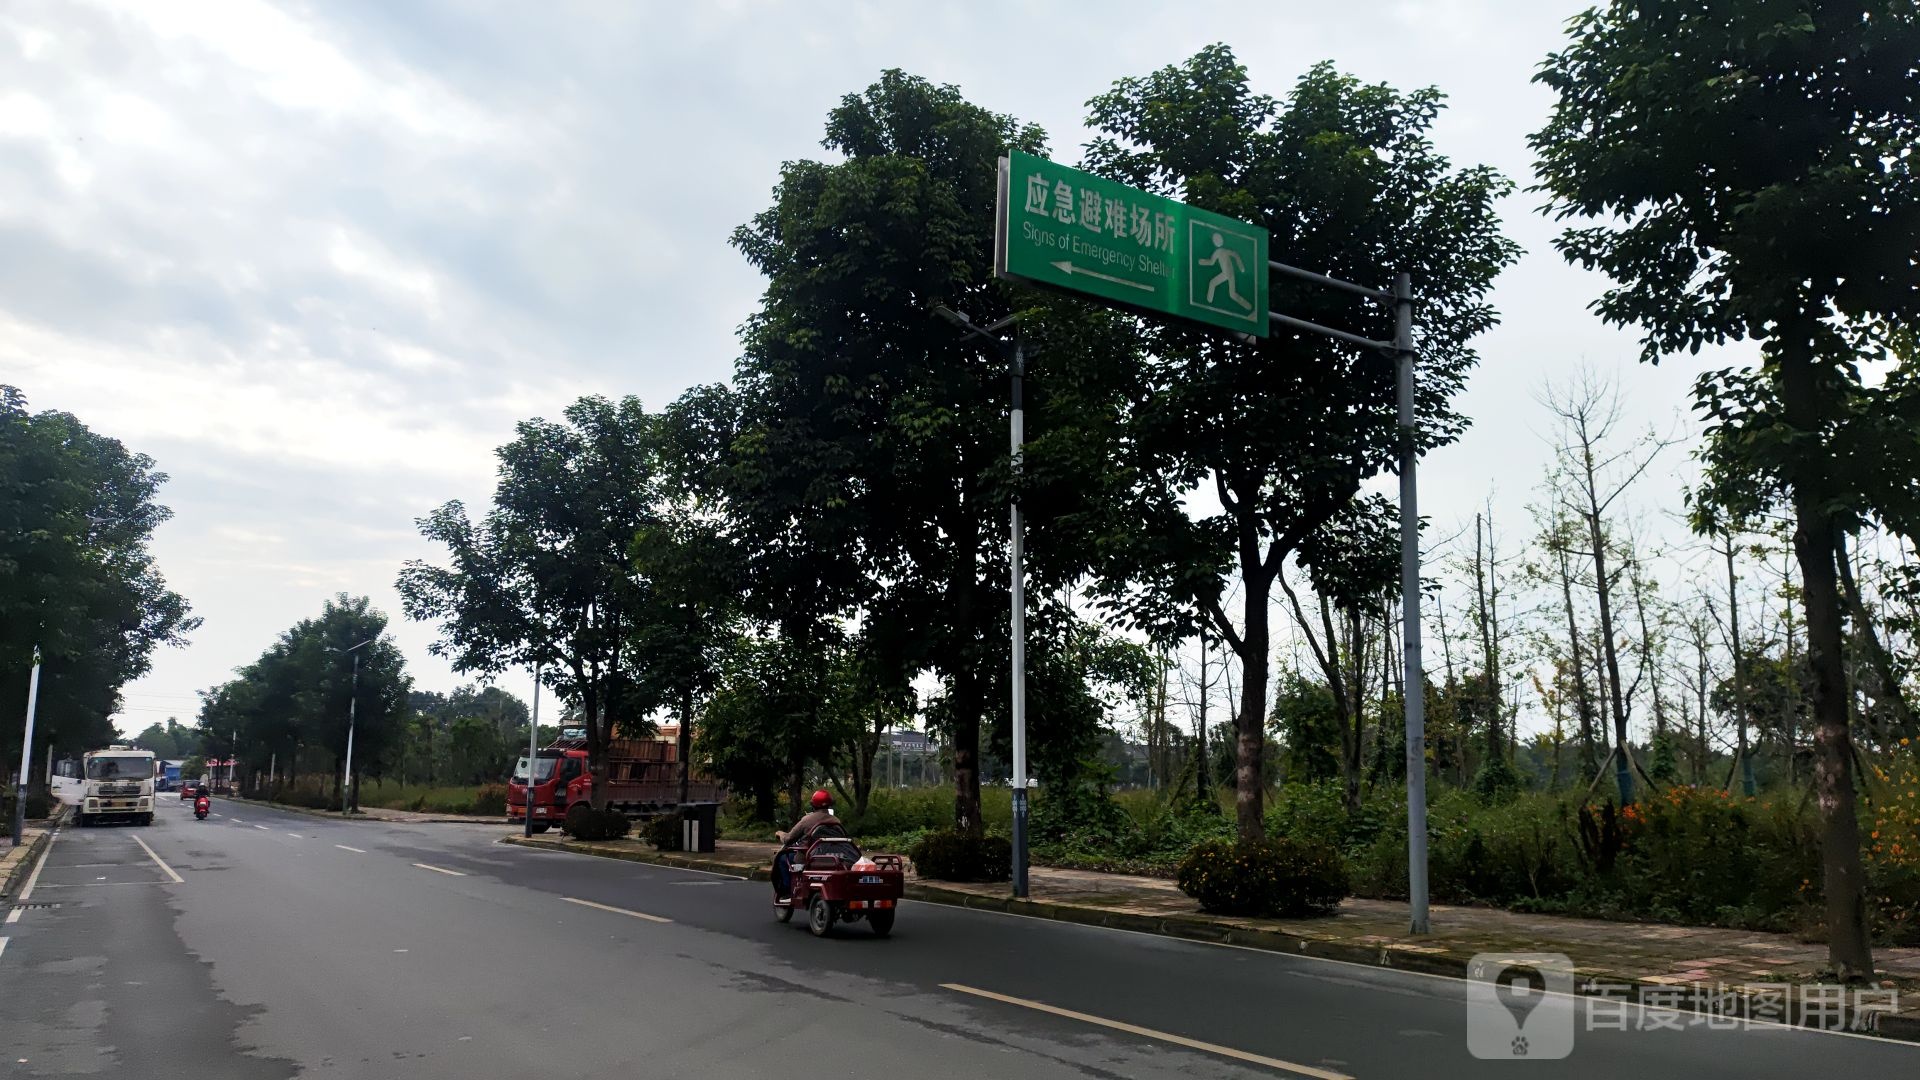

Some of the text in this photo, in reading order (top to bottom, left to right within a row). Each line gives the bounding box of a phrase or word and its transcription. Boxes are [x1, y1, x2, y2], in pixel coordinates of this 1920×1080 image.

[1025, 173, 1175, 254] 应急避难场所
[1023, 221, 1175, 279] Signs of Emergency Sheltr
